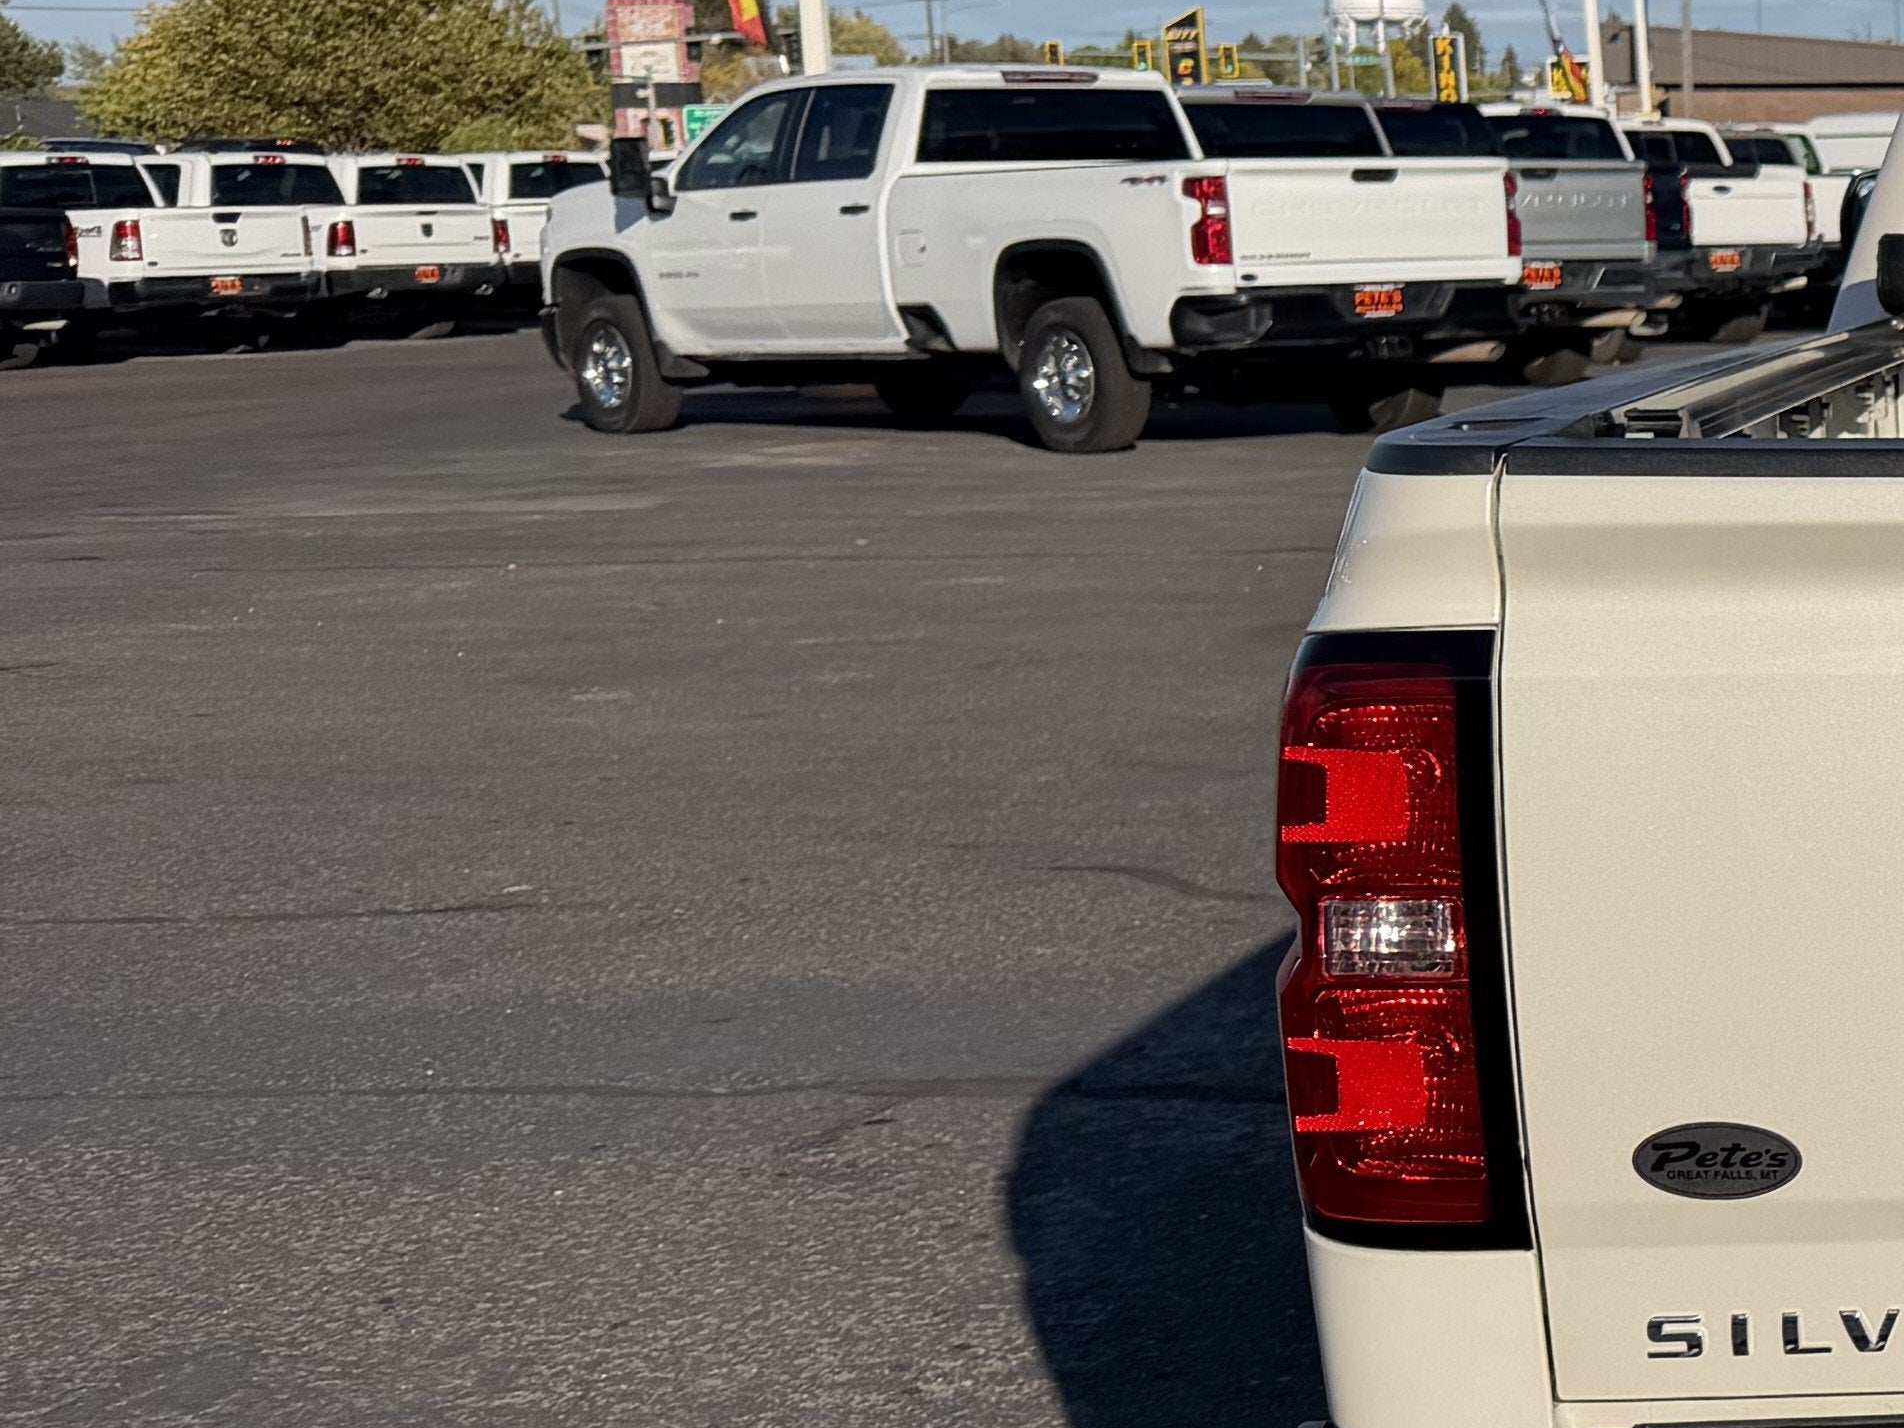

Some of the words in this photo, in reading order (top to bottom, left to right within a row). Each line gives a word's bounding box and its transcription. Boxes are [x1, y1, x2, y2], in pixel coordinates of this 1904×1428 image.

[1650, 1140, 1788, 1172] Pete's
[1666, 1169, 1711, 1180] GREAT
[1714, 1169, 1758, 1181] FALLS,
[1760, 1169, 1779, 1180] MT
